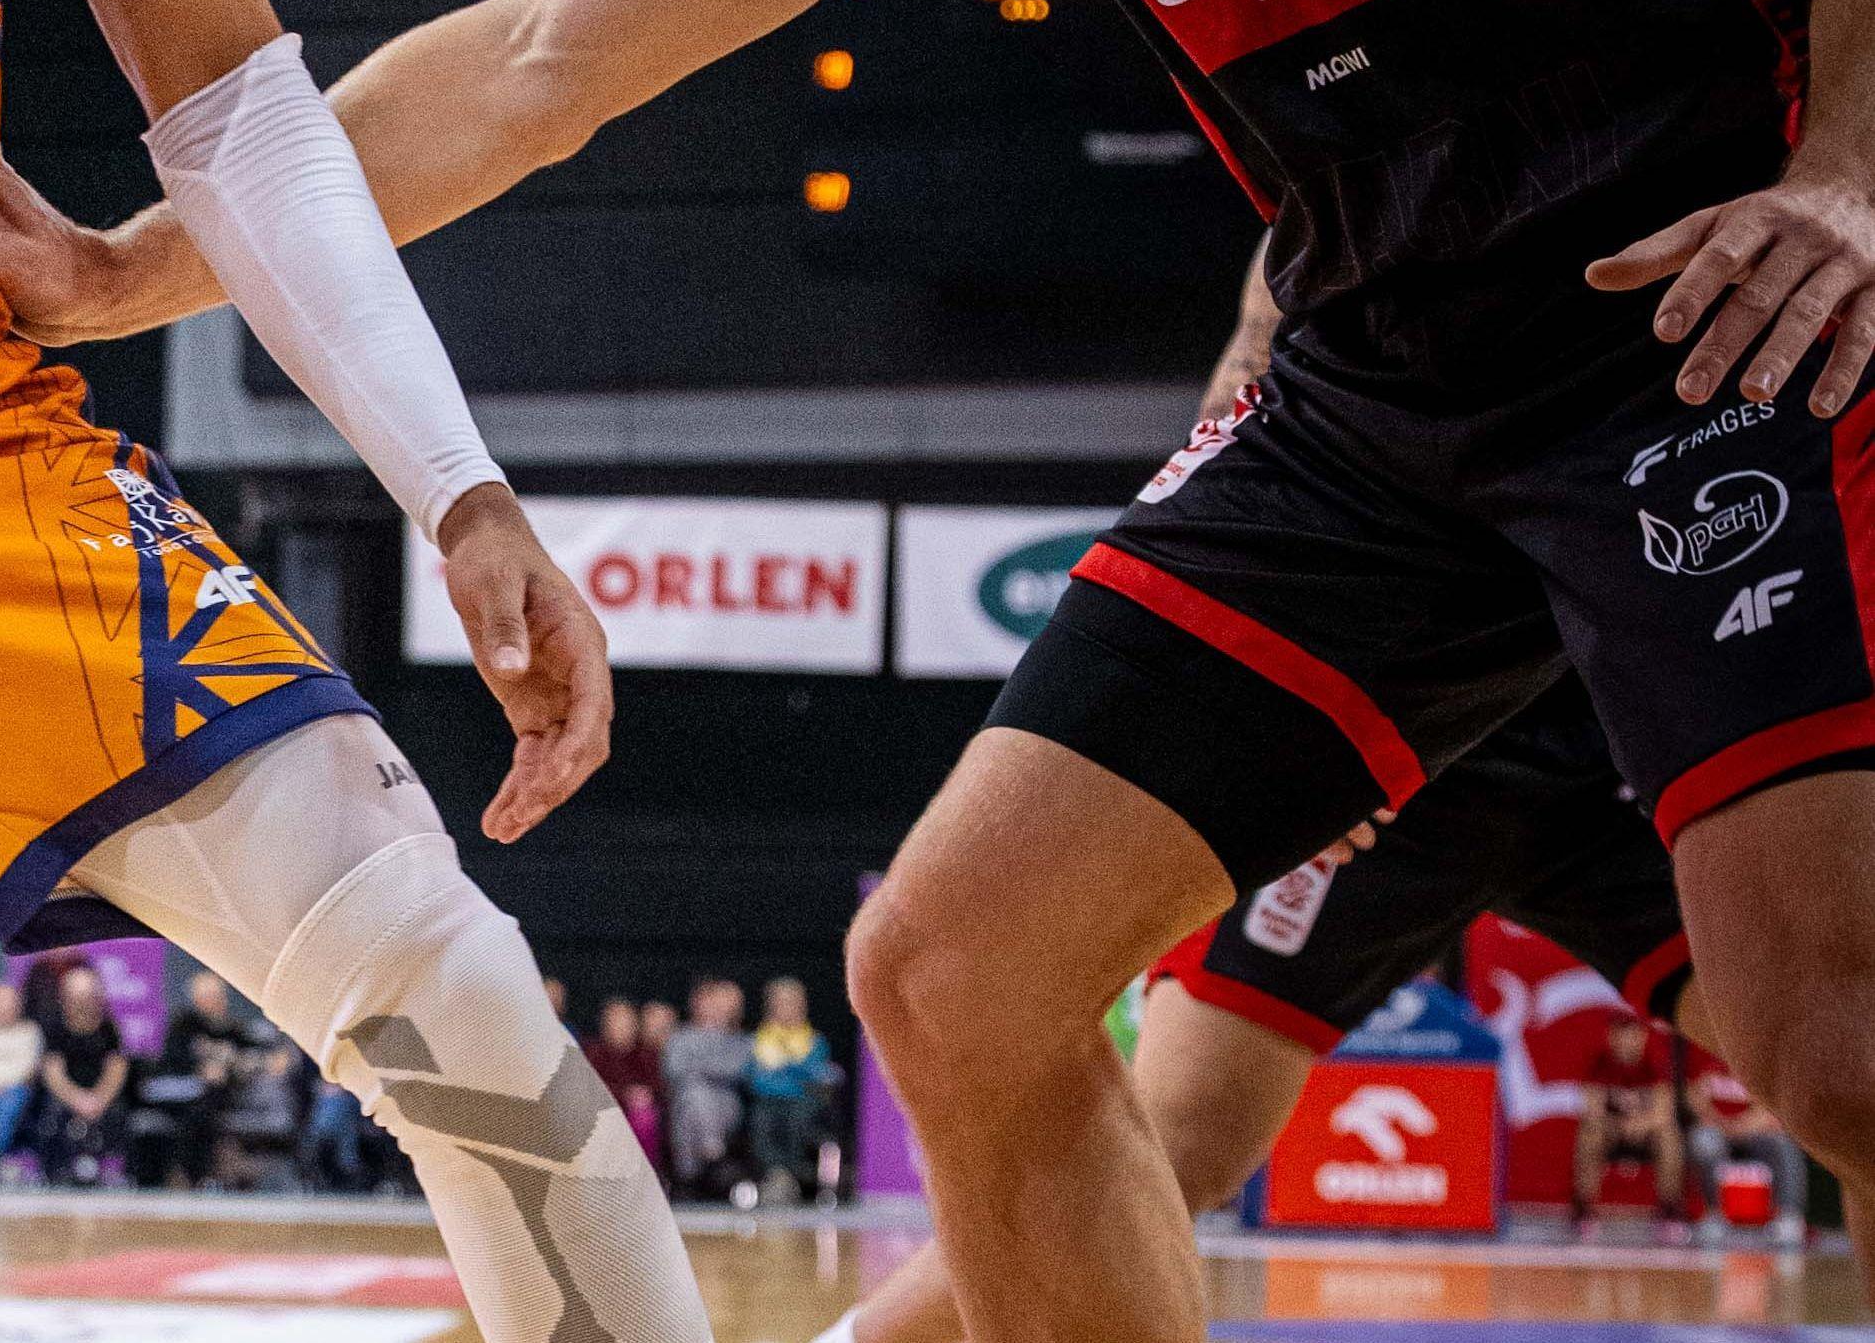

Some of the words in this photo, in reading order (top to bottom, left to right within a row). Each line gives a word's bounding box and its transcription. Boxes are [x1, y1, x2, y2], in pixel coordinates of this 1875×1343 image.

[1676, 398, 1776, 458] FRAGES
[195, 564, 257, 610] 4F
[586, 550, 860, 616] ORLEN
[1713, 569, 1805, 642] 4F
